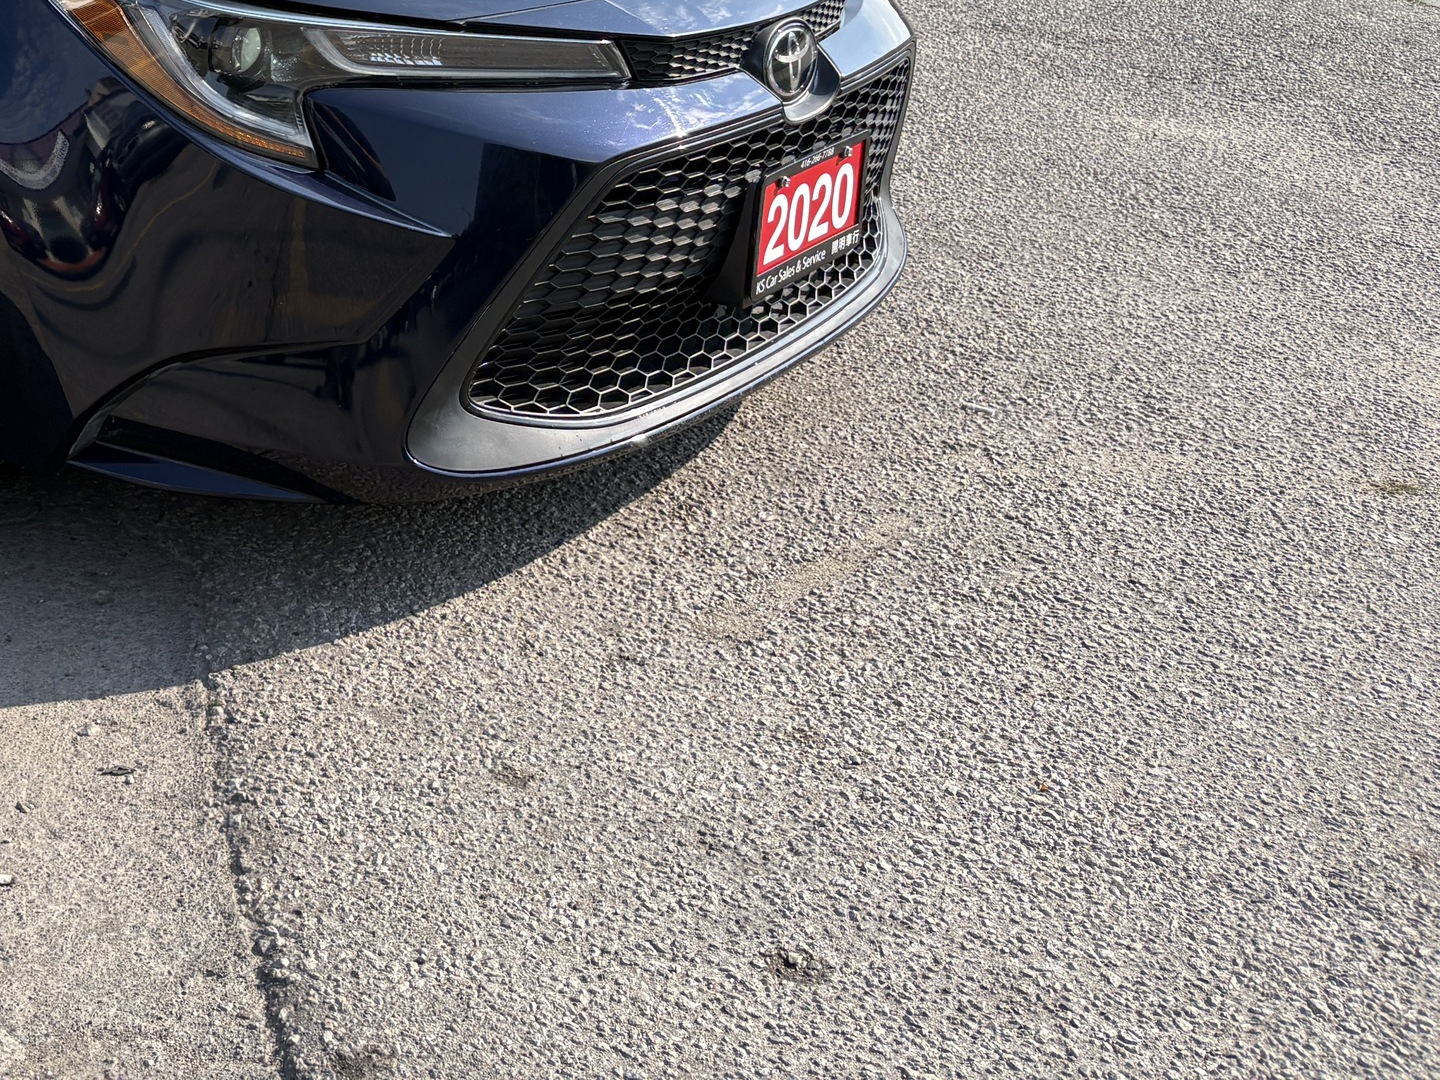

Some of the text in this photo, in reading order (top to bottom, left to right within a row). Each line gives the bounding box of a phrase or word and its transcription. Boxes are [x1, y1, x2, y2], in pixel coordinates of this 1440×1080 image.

[762, 162, 855, 266] 2020
[755, 279, 766, 296] KS
[765, 274, 779, 290] Car
[778, 266, 796, 284] Sales
[802, 249, 826, 270] Service
